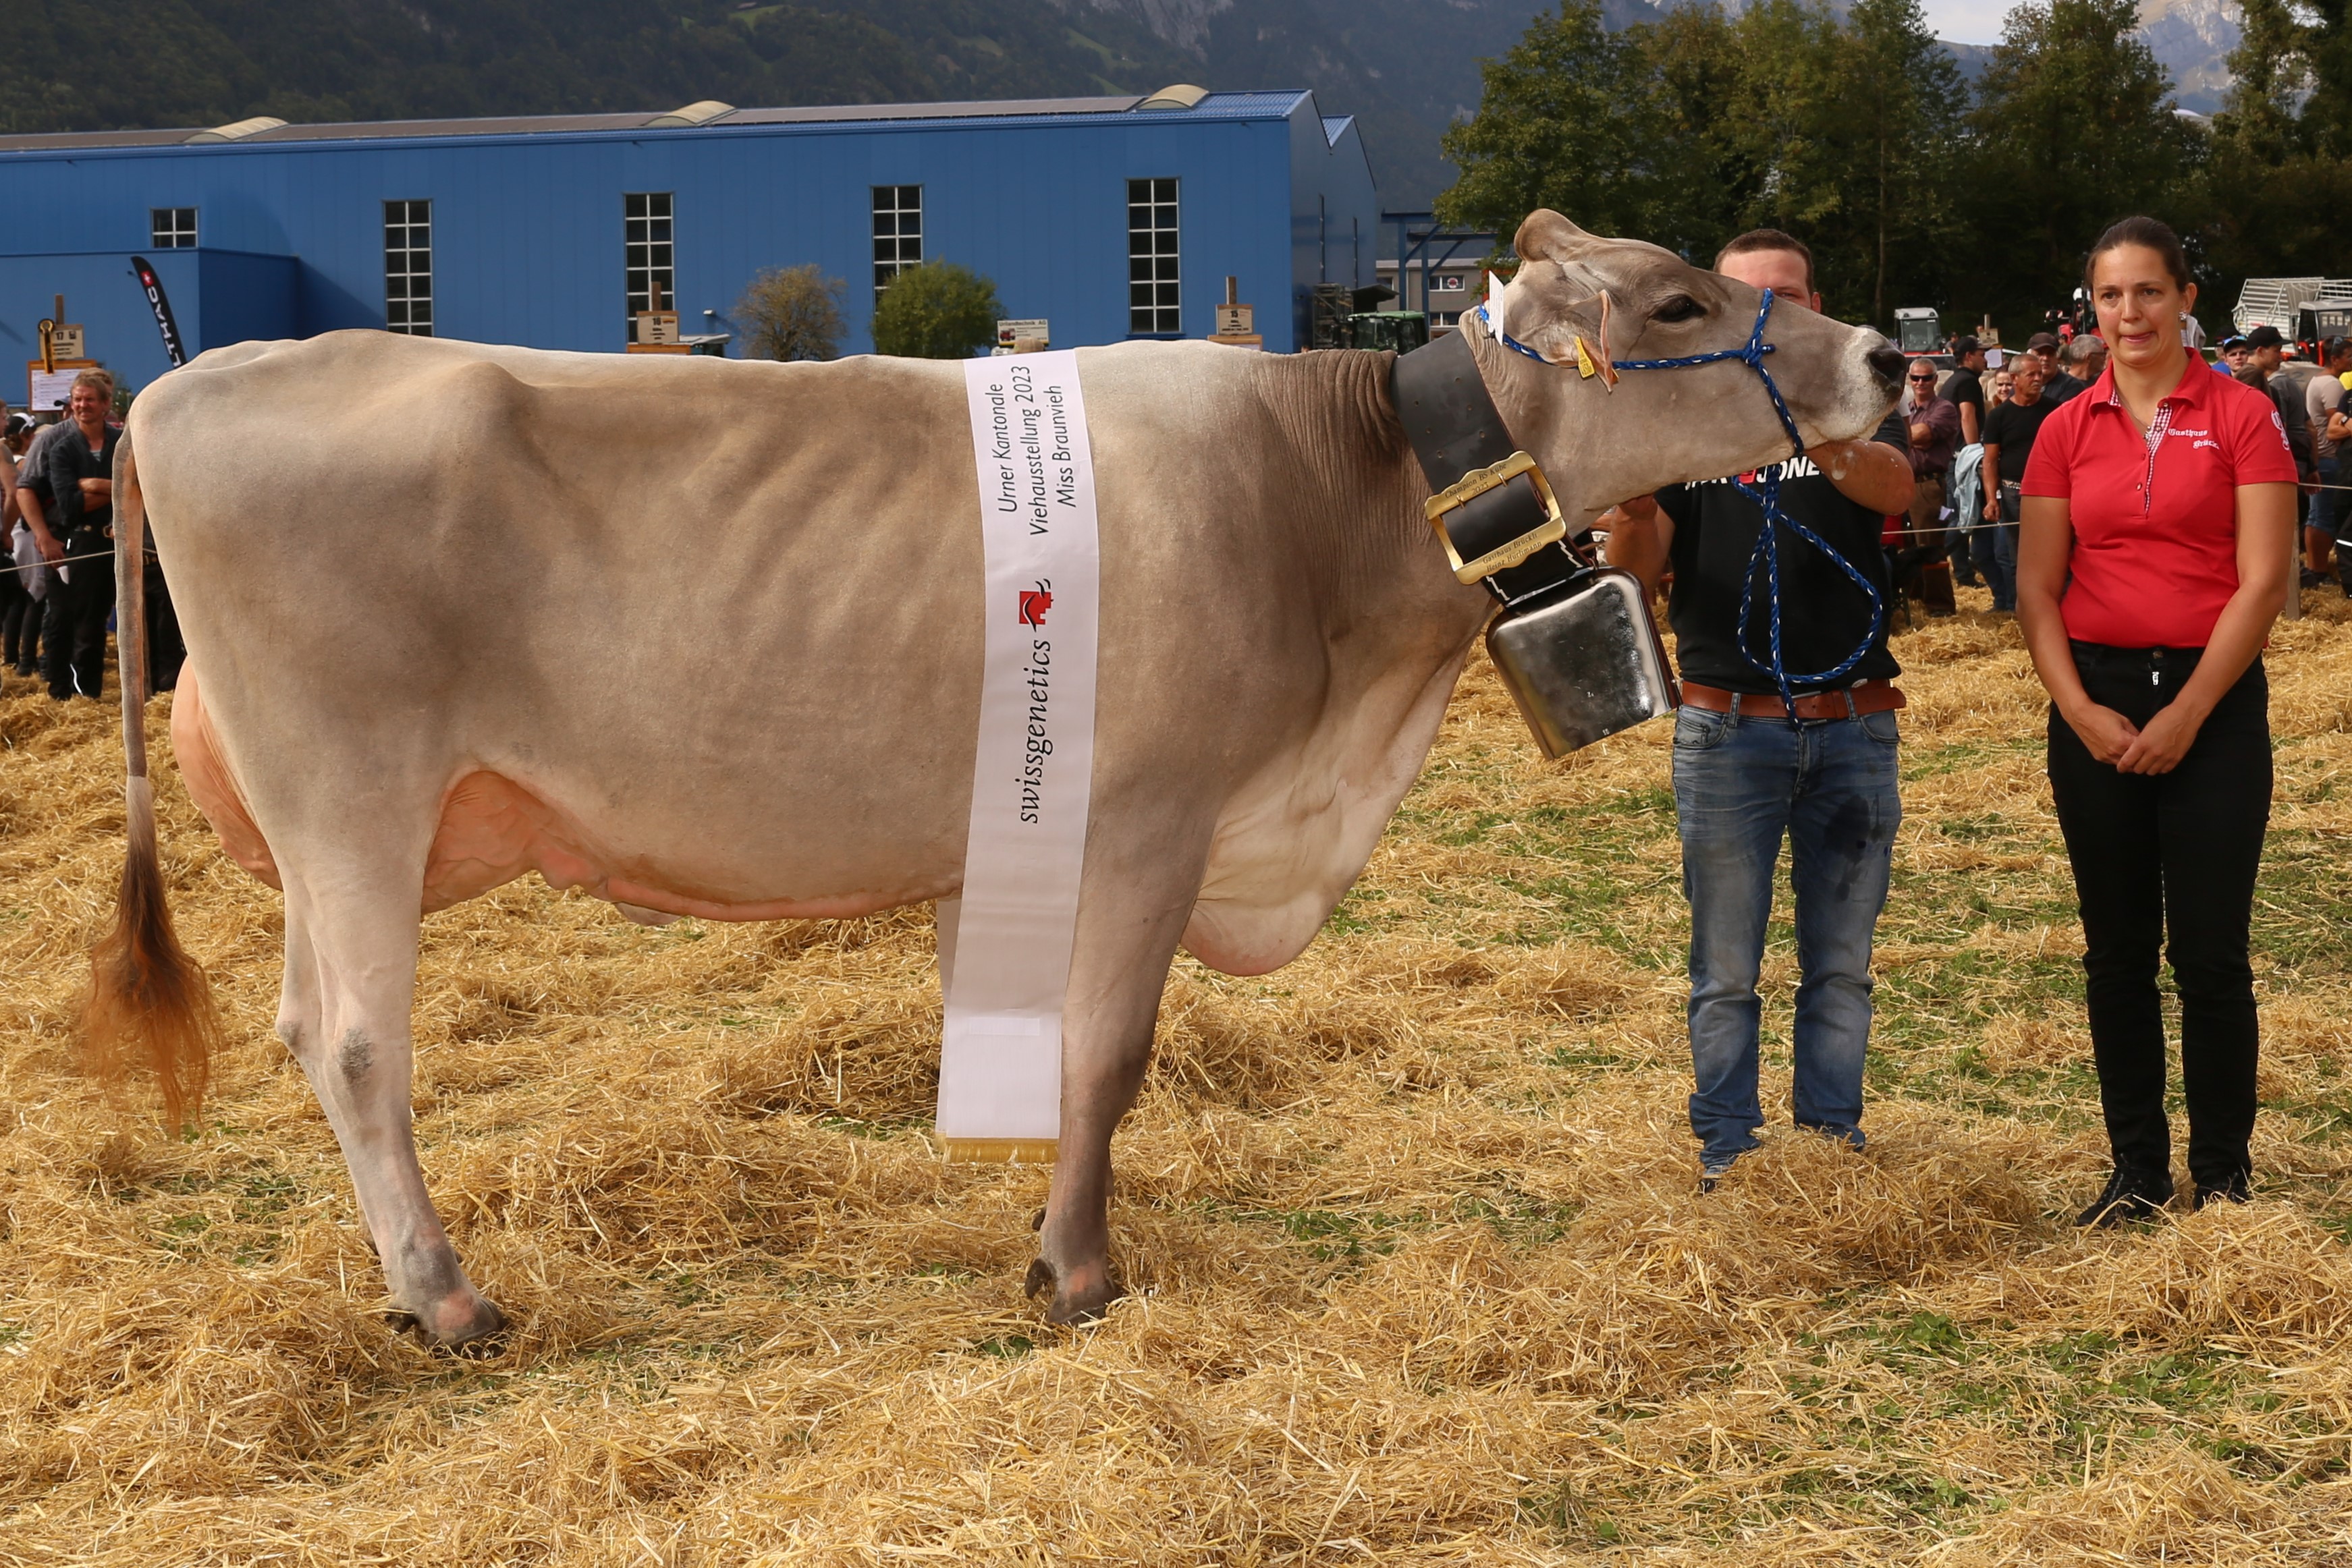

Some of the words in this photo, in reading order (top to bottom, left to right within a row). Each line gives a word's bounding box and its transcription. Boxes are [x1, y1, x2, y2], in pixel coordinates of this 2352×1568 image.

[1230, 310, 1238, 318] 15
[56, 331, 64, 340] 17
[1011, 366, 1034, 403] 2023
[985, 383, 1012, 460] Kantonale
[1043, 385, 1072, 461] Braunvieh
[2168, 428, 2208, 438] Gasthaus
[997, 464, 1018, 513] Urner
[1020, 408, 1049, 536] Viehausstellung
[1056, 468, 1076, 508] Miss
[1445, 479, 1477, 499] Champion
[1479, 473, 1488, 481] BS
[1472, 482, 1489, 496] 2023
[1482, 546, 1512, 564] Gasthaus
[1513, 532, 1537, 549] Brückli
[1486, 559, 1506, 573] Heinz
[1015, 640, 1054, 824] swissgenetics
